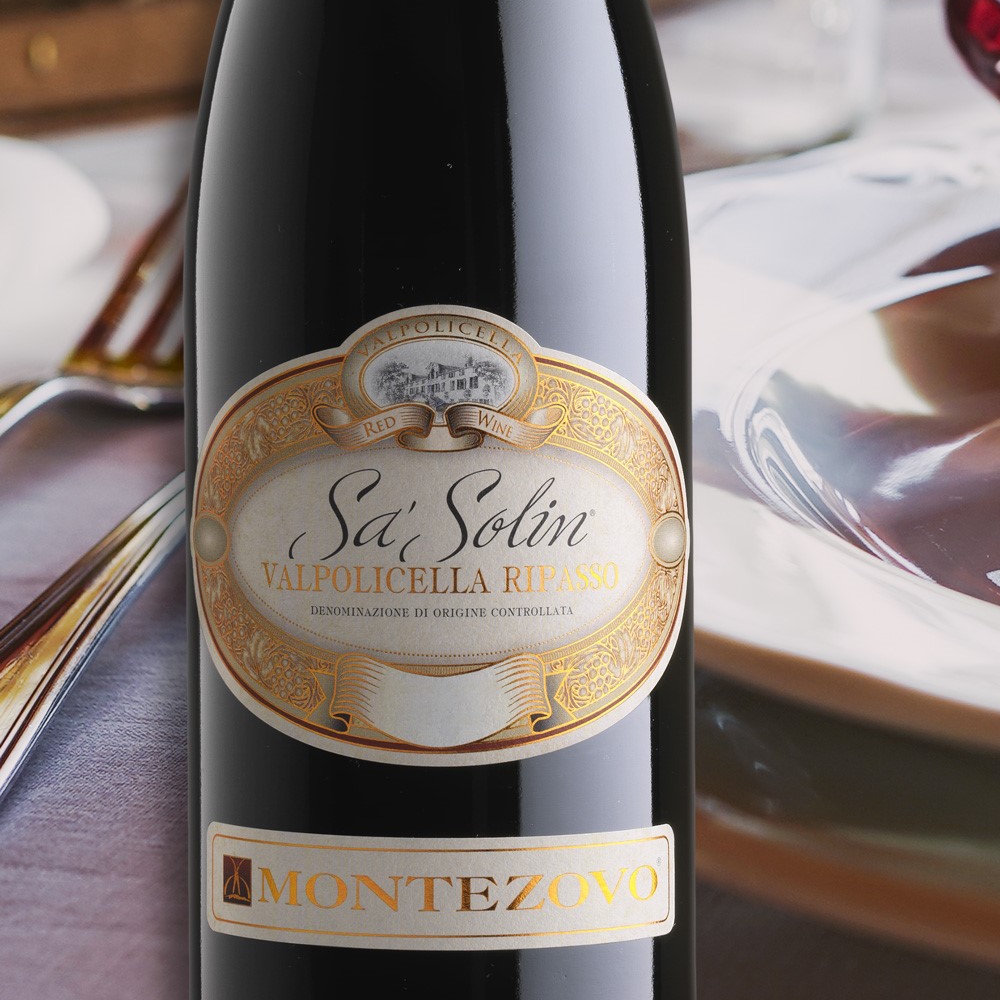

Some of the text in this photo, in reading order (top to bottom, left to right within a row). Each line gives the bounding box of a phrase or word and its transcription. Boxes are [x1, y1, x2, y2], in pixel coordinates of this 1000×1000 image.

[355, 318, 525, 364] VALPOLICELLA
[261, 560, 620, 595] VALPOLICELLA RIPASSO
[310, 604, 574, 619] DENOMINAZIONE DI ORIGINE CONTROLLATA
[257, 863, 659, 913] MONTEZOVO
